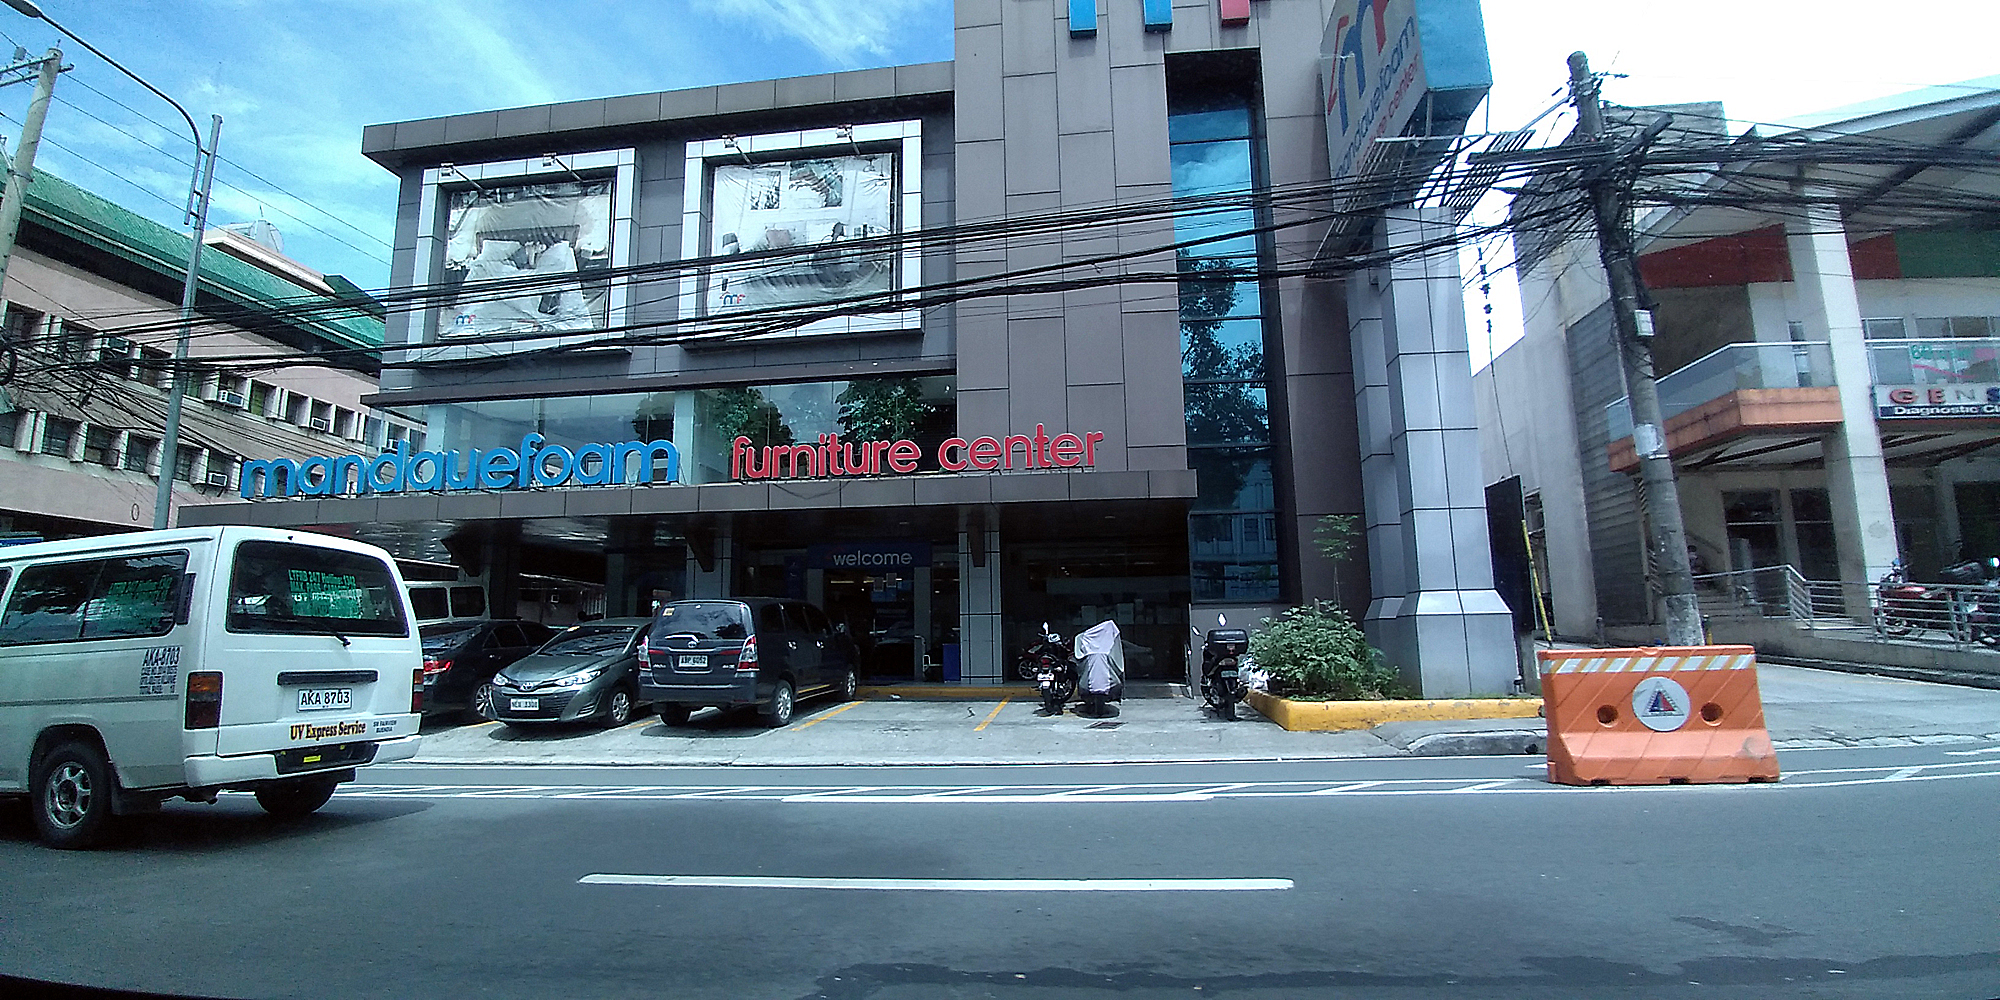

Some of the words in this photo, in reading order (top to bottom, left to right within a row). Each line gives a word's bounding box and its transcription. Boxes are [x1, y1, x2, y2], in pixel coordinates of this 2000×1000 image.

[1894, 405, 1978, 415] Diagnostic
[732, 432, 921, 480] furniture
[938, 423, 1104, 471] center
[241, 433, 681, 498] mandauefoam
[833, 550, 913, 566] welcome
[142, 646, 181, 666] AKA-8703
[301, 692, 321, 705] AKA
[324, 691, 350, 704] 8703
[290, 724, 304, 740] UV
[305, 722, 338, 741] Express
[338, 720, 366, 736] Service
